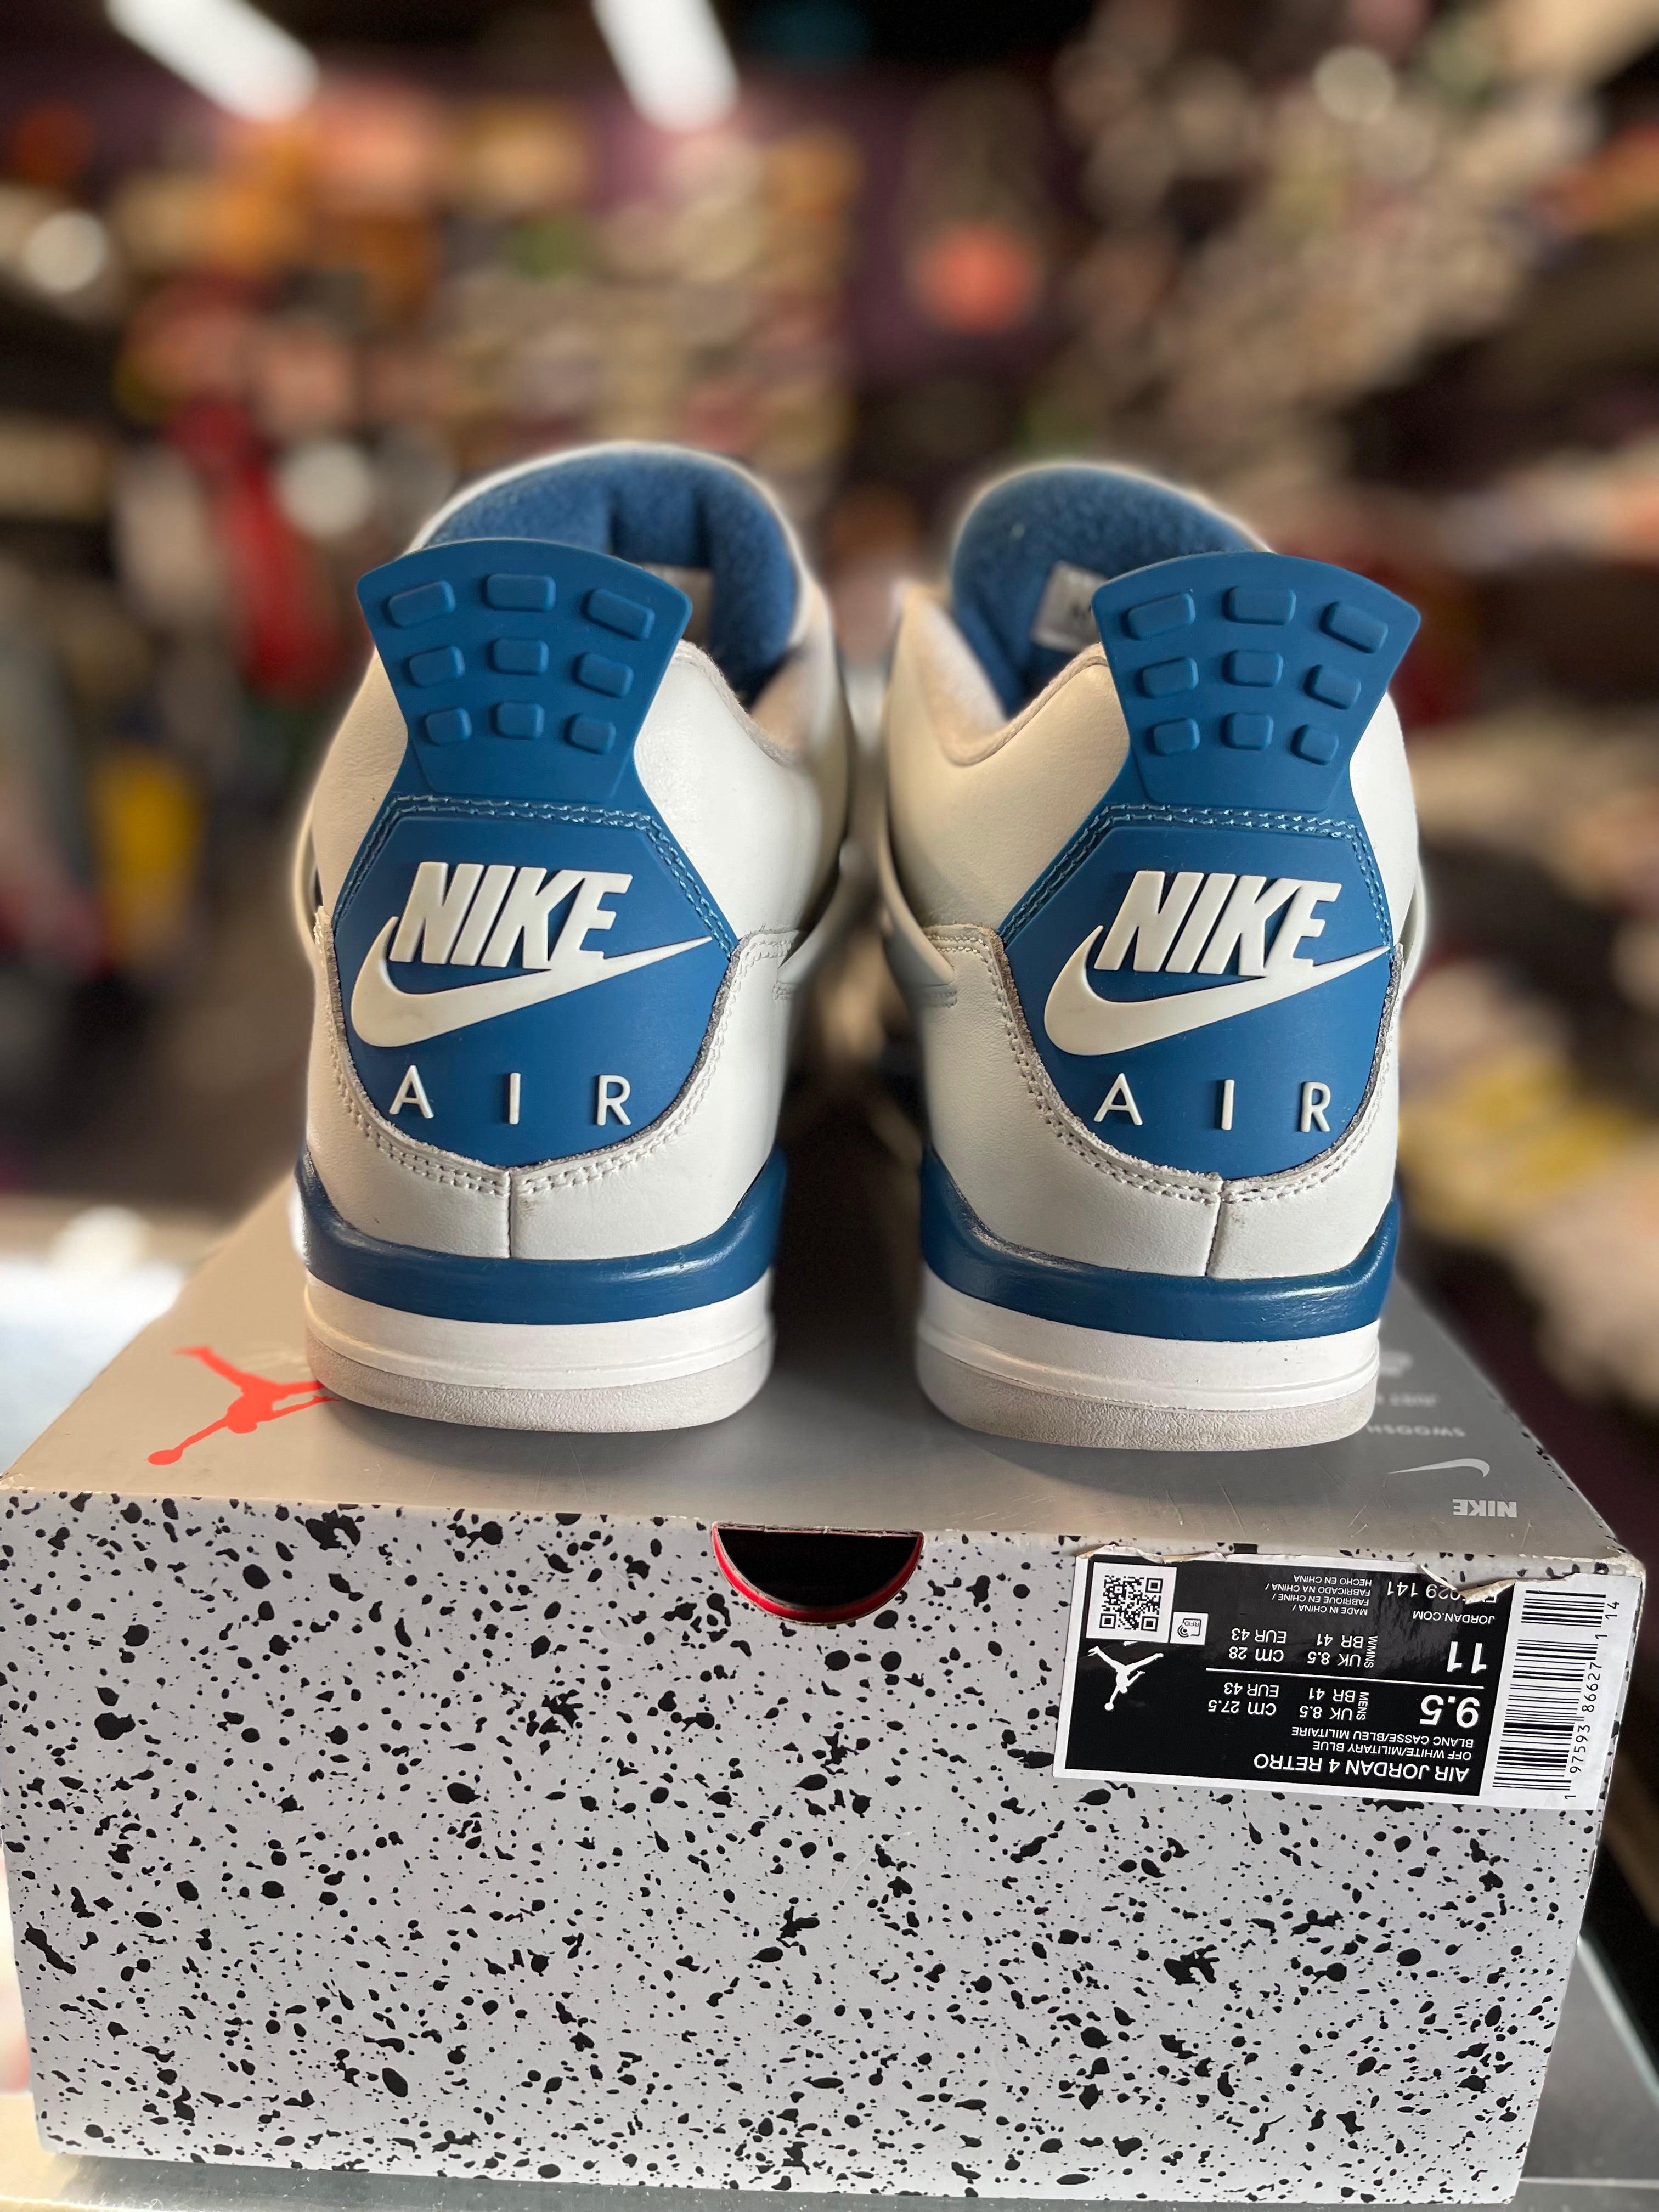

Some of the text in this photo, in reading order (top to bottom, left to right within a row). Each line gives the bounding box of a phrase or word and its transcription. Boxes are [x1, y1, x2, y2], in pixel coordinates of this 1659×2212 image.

[390, 861, 633, 970] NIKE
[1094, 871, 1342, 978] NIKE
[390, 1065, 631, 1125] AIR
[1094, 1073, 1330, 1132] AIR
[1452, 1499, 1517, 1518] NIKE
[1271, 1583, 1300, 1593] CHINA
[1293, 1575, 1372, 1587] HECHO EN CHINA
[1302, 1585, 1316, 1593] NA
[1277, 1593, 1306, 1602] CHINE
[1318, 1586, 1371, 1597] FABRICADO
[1387, 1581, 1497, 1603] 029 141
[1298, 1604, 1328, 1613] CHINA
[1323, 1596, 1369, 1606] FABRIQUE
[1329, 1606, 1339, 1614] IN
[1340, 1607, 1368, 1616] MADE
[1412, 1610, 1495, 1624] JORDAN.COM
[1605, 1602, 1620, 1620] 14
[1231, 1628, 1287, 1644] EUR 43
[1316, 1633, 1364, 1649] BR 41
[1229, 1646, 1284, 1662] cm 28
[1307, 1651, 1361, 1667] UK 8.5
[1364, 1635, 1378, 1668] WMNS
[1446, 1641, 1487, 1674] 11
[1224, 1682, 1279, 1698] EUR 43
[1308, 1688, 1356, 1703] BR 41
[1207, 1699, 1277, 1716] cm 27.5
[1299, 1705, 1353, 1721] UK 8.5
[1356, 1691, 1369, 1720] MENS
[1419, 1694, 1480, 1728] 9.5
[1570, 1725, 1590, 1774] 97593
[1582, 1662, 1602, 1712] 86627
[1291, 1726, 1474, 1748] BLANC CASSE/BLEU MILITAIRE
[1312, 1741, 1472, 1760] OFF WHITE/MILITARY BLUE
[1254, 1753, 1470, 1782] AIR JORDAN 4 RETRO
